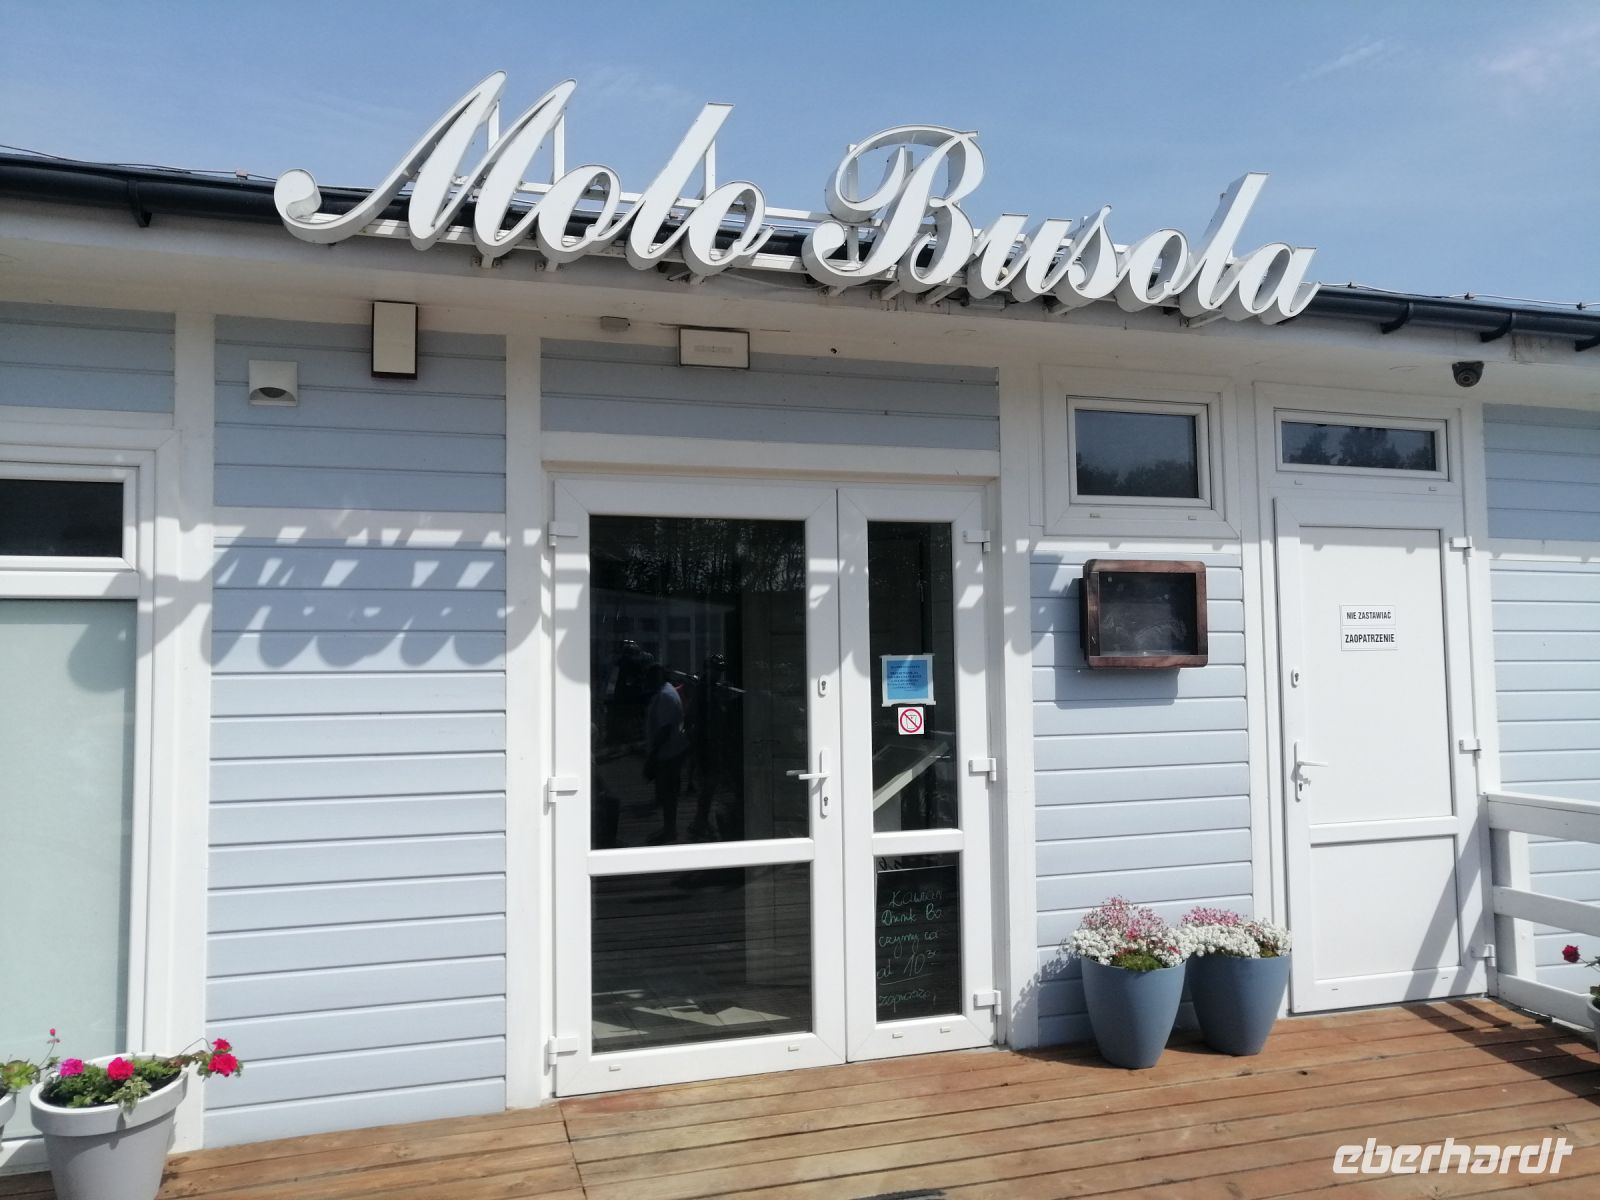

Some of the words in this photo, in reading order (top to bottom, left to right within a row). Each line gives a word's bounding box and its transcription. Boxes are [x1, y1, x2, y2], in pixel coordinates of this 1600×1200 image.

[273, 69, 776, 276] Molo
[802, 124, 1322, 325] Busola
[1347, 611, 1356, 619] NIE
[1344, 633, 1395, 643] ZAOPATRZENIE
